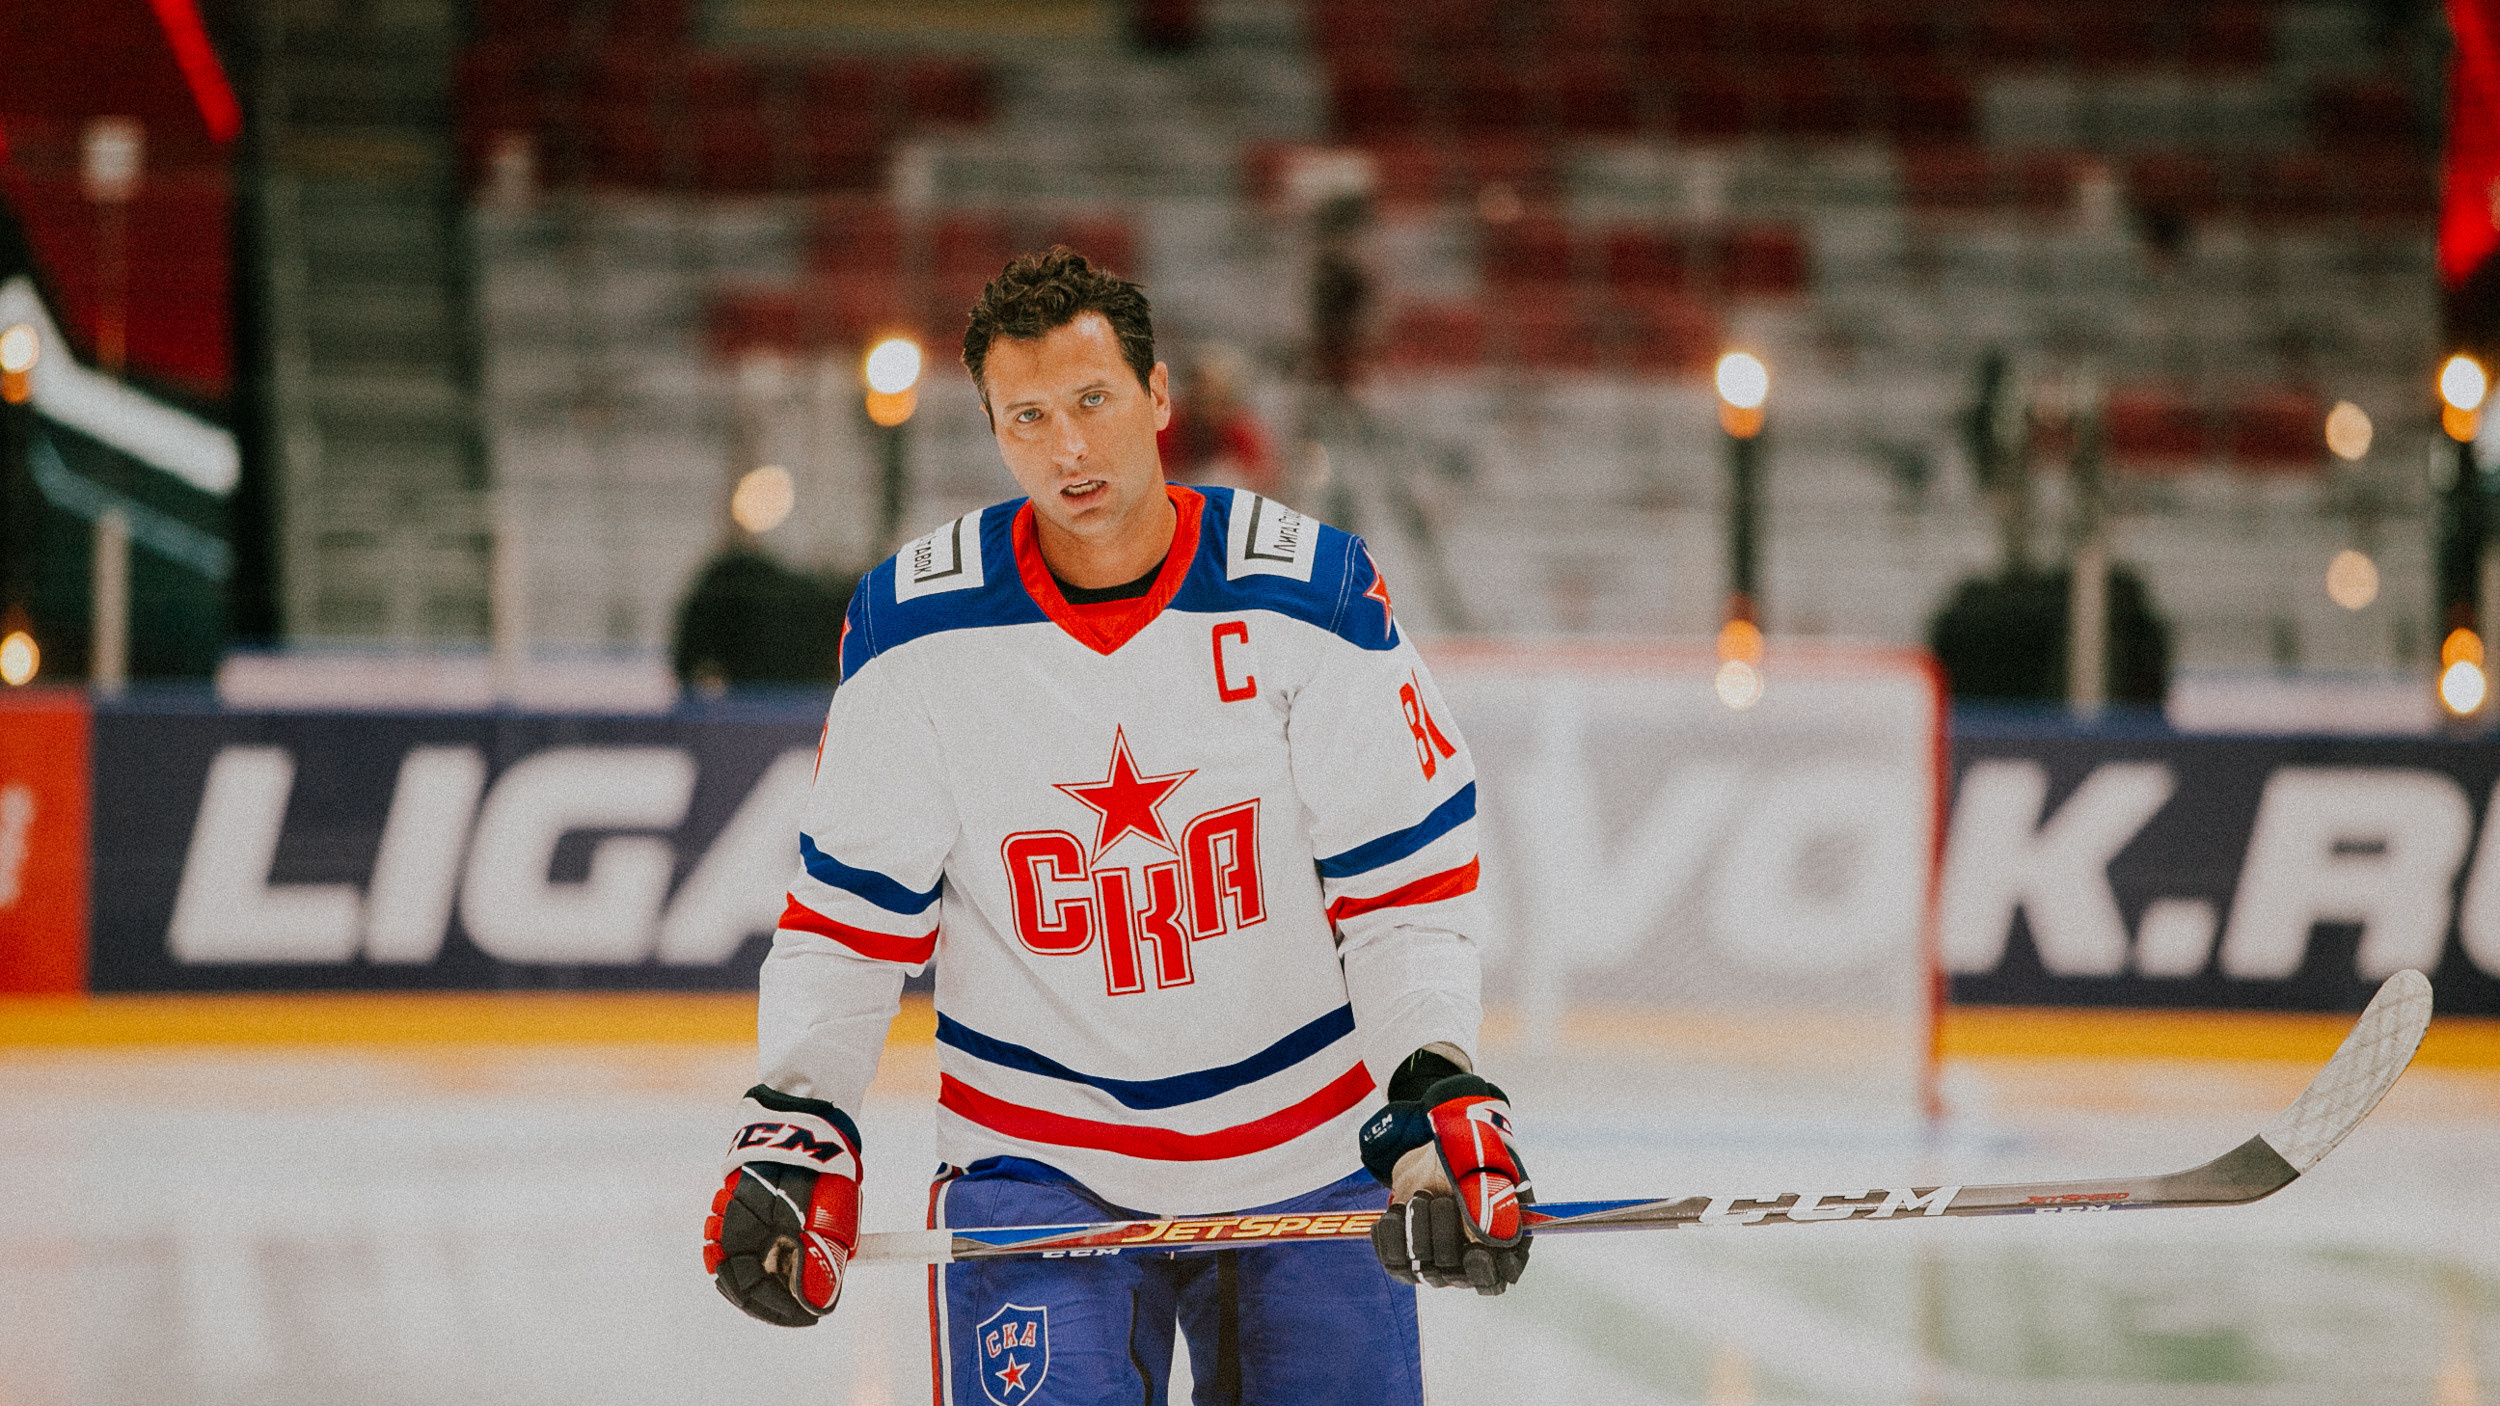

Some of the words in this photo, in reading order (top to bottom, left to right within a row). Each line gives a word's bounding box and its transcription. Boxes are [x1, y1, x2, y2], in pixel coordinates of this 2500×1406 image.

[1212, 621, 1257, 703] C
[1000, 797, 1268, 997] СКА
[726, 1122, 845, 1164] CM
[1698, 1185, 1963, 1224] CCM
[1121, 1214, 1383, 1243] JETSPEE
[1042, 1248, 1121, 1259] CCM
[985, 1321, 1038, 1359] СКА
